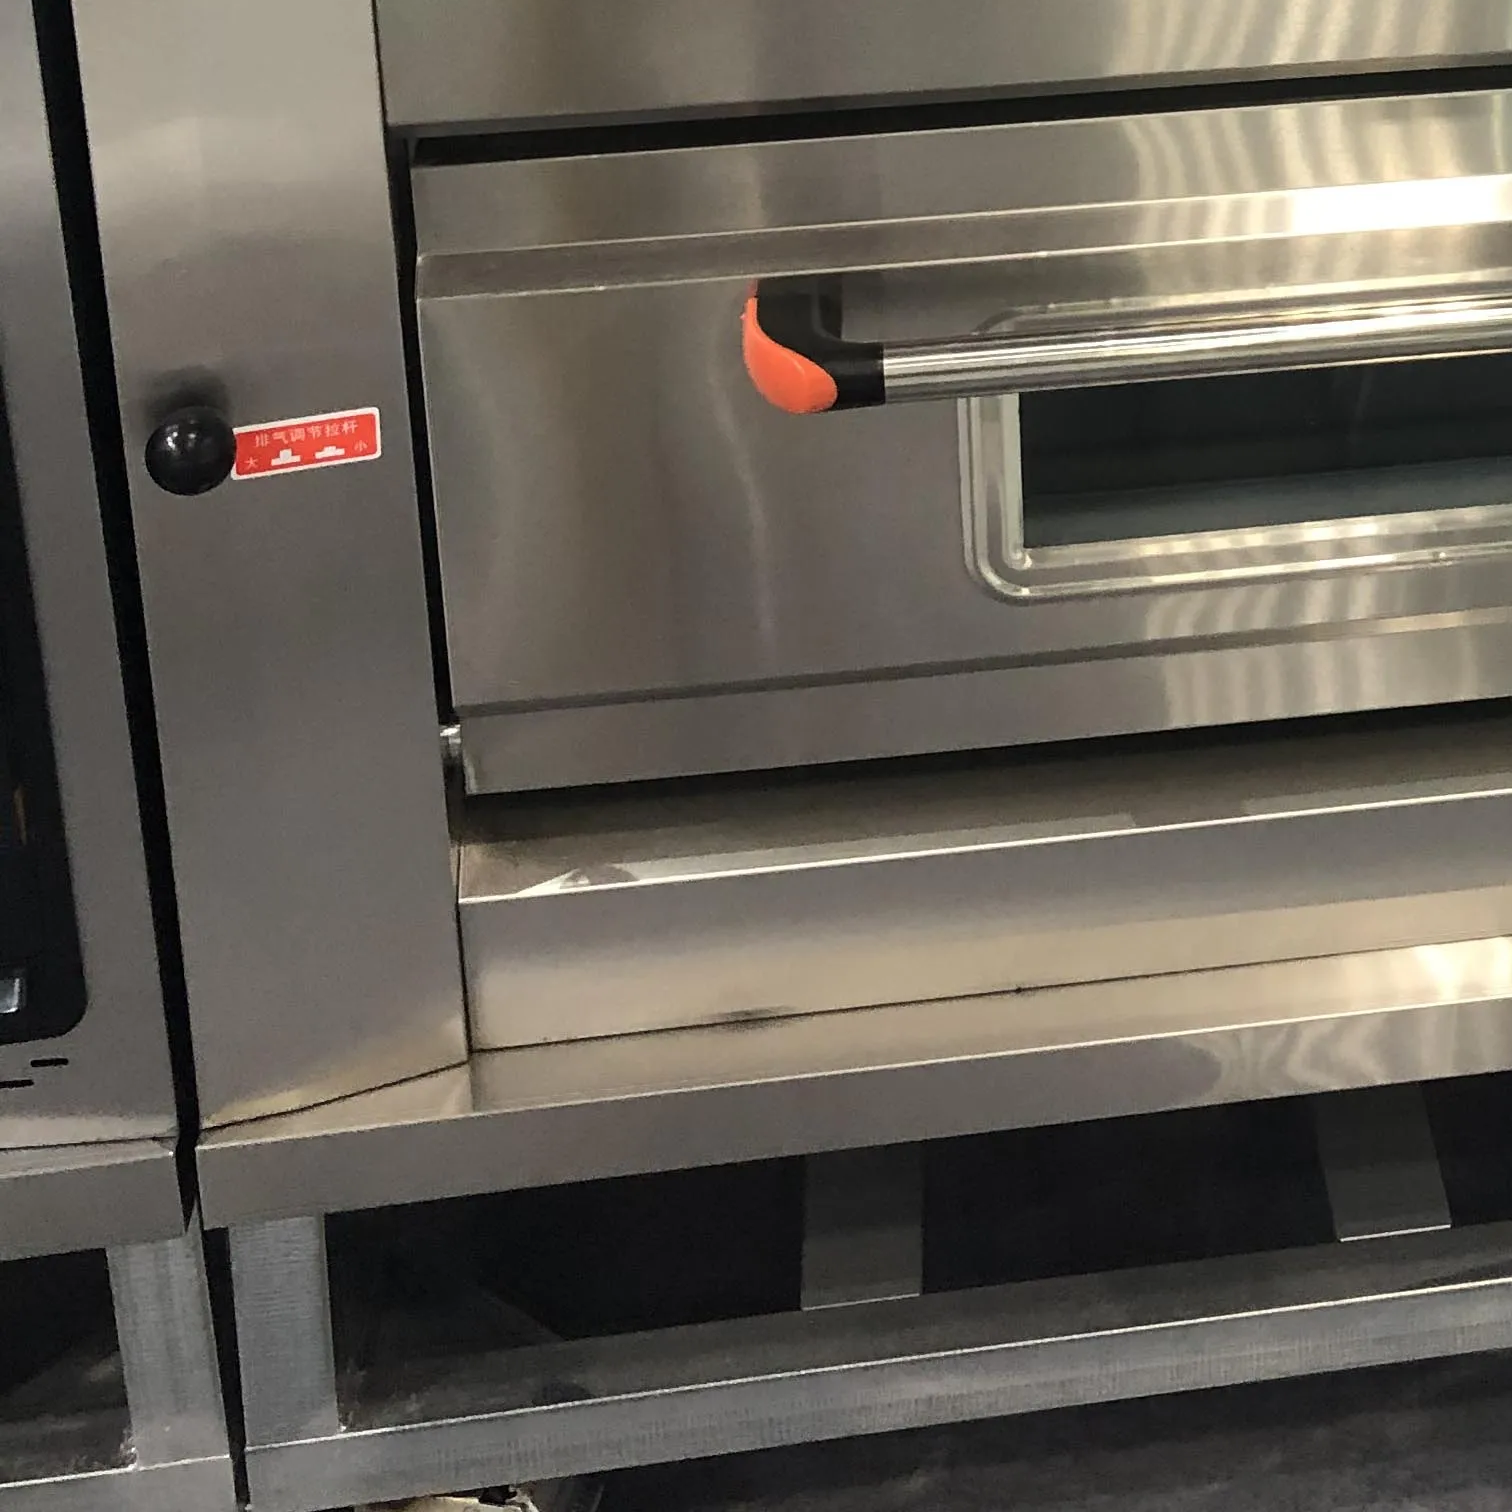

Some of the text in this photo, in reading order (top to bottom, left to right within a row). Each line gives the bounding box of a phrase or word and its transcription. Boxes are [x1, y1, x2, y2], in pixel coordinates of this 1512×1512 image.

[254, 418, 359, 448] 排气调节拉杆
[245, 439, 368, 470] 大 小
